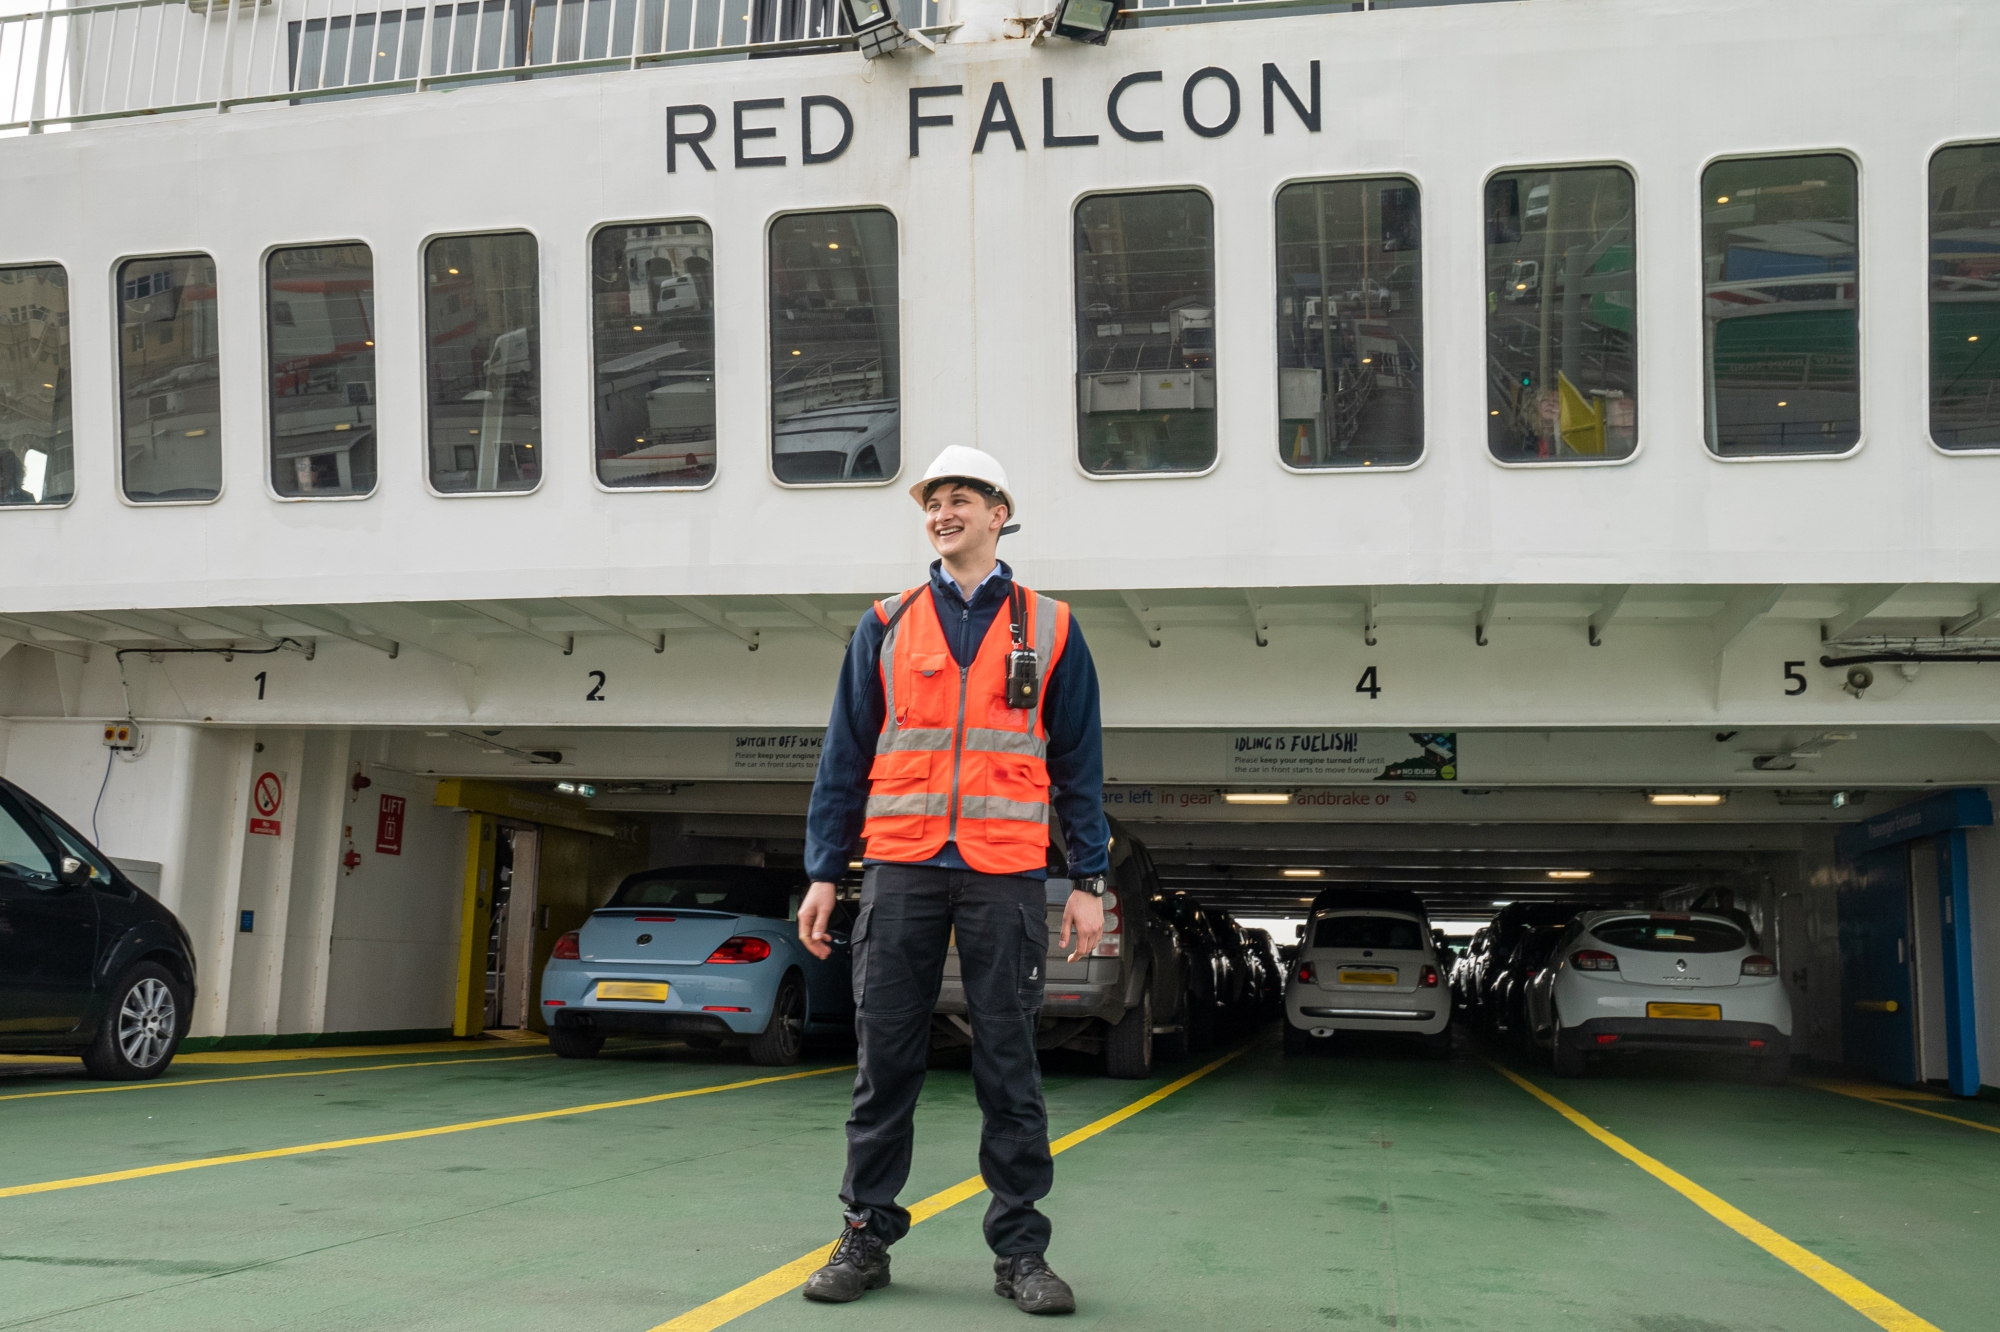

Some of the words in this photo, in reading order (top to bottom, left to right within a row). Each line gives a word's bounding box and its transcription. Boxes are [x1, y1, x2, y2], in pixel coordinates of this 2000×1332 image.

[666, 95, 854, 173] RED
[908, 60, 1322, 158] FALCON
[254, 671, 267, 700] 1
[586, 670, 606, 701] 2
[1355, 665, 1382, 700] 4
[1783, 660, 1808, 696] 5
[736, 736, 766, 748] SWITCH
[767, 736, 777, 747] IT
[779, 735, 798, 748] OFF
[799, 737, 808, 748] SO
[1234, 736, 1272, 752] IDLING
[1275, 736, 1286, 750] IS
[1290, 732, 1358, 752] FUELISH!
[758, 752, 774, 761] keep
[792, 752, 816, 761] engine
[1234, 756, 1258, 764] Please
[1260, 756, 1278, 765] keep
[1298, 756, 1325, 765] engine
[1326, 756, 1352, 764] turned
[1353, 756, 1366, 764] off
[1271, 765, 1290, 773] front
[1315, 766, 1323, 774] to
[381, 797, 403, 815] LIFT
[1128, 790, 1153, 804] left
[1161, 790, 1174, 804] in
[1180, 792, 1214, 808] gear
[1297, 791, 1370, 805] andbrake
